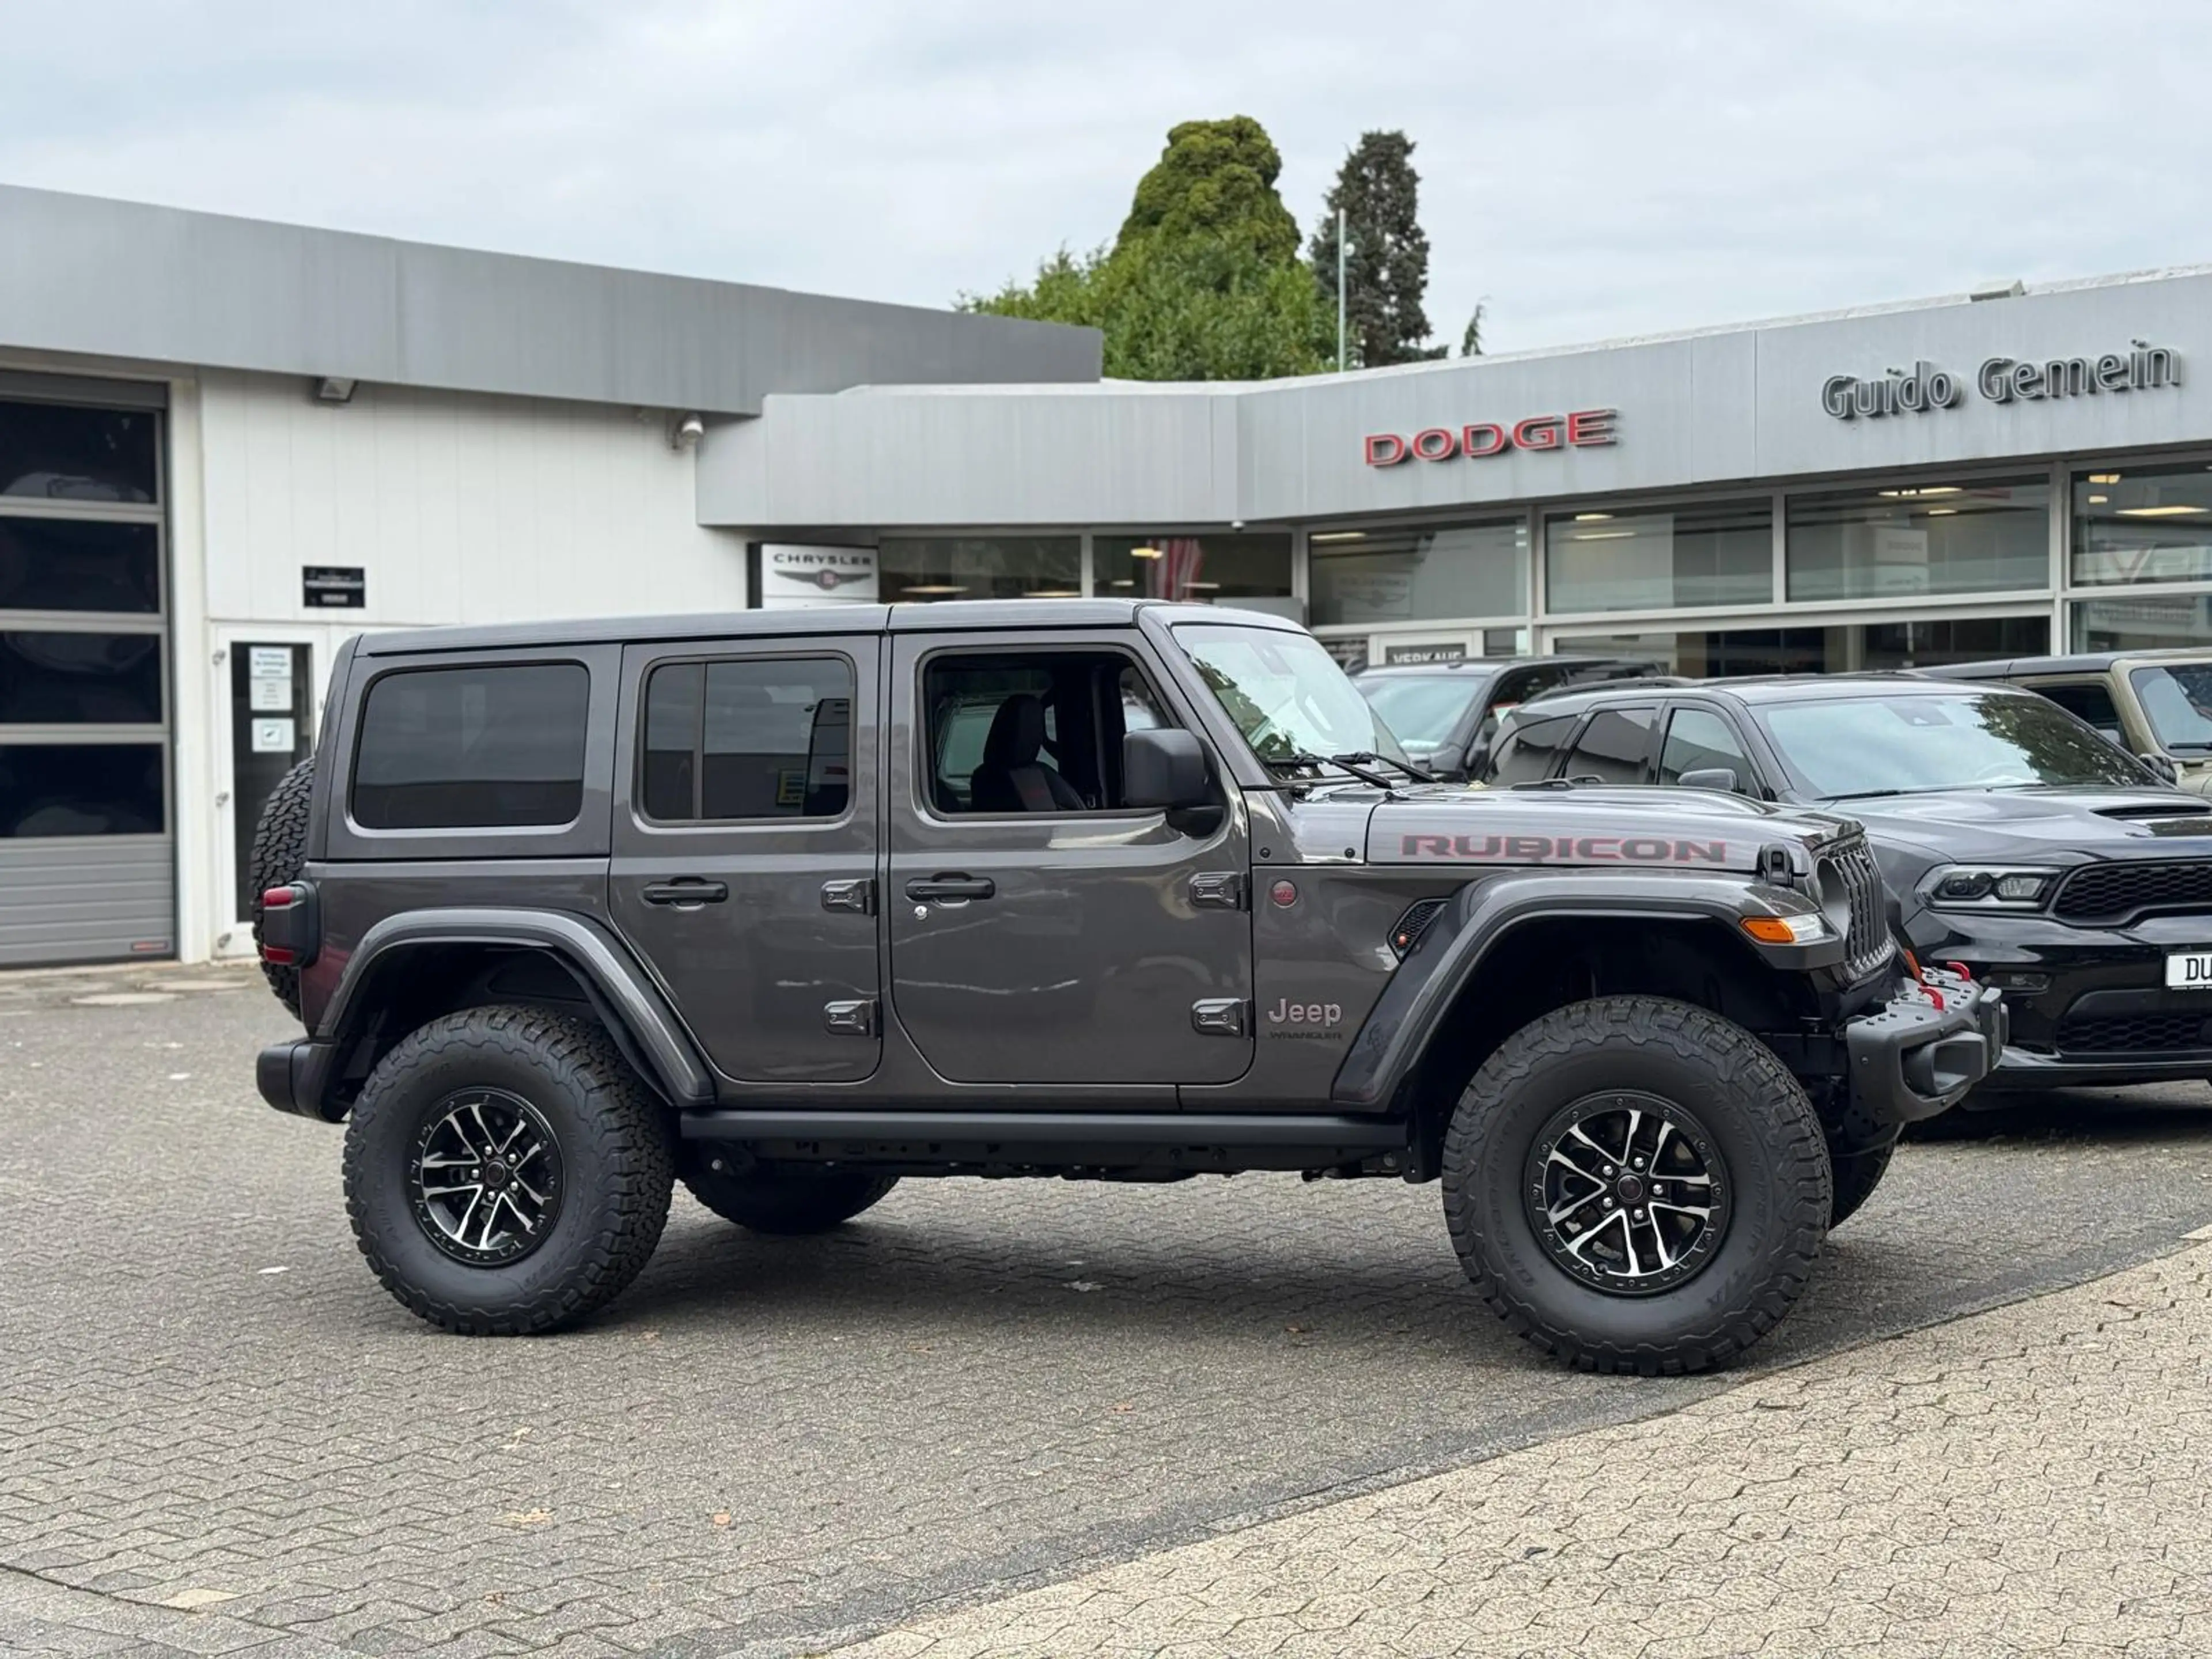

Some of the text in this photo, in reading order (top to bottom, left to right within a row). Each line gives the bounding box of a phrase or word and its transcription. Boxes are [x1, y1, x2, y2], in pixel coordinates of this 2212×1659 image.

[1821, 339, 2182, 420] Guido Gemein
[1364, 408, 1618, 468] DODGE
[772, 552, 872, 566] CHRYSLER
[1402, 834, 1727, 863] RUBICON
[2185, 957, 2212, 981] DU
[1267, 998, 1342, 1027] Jeep
